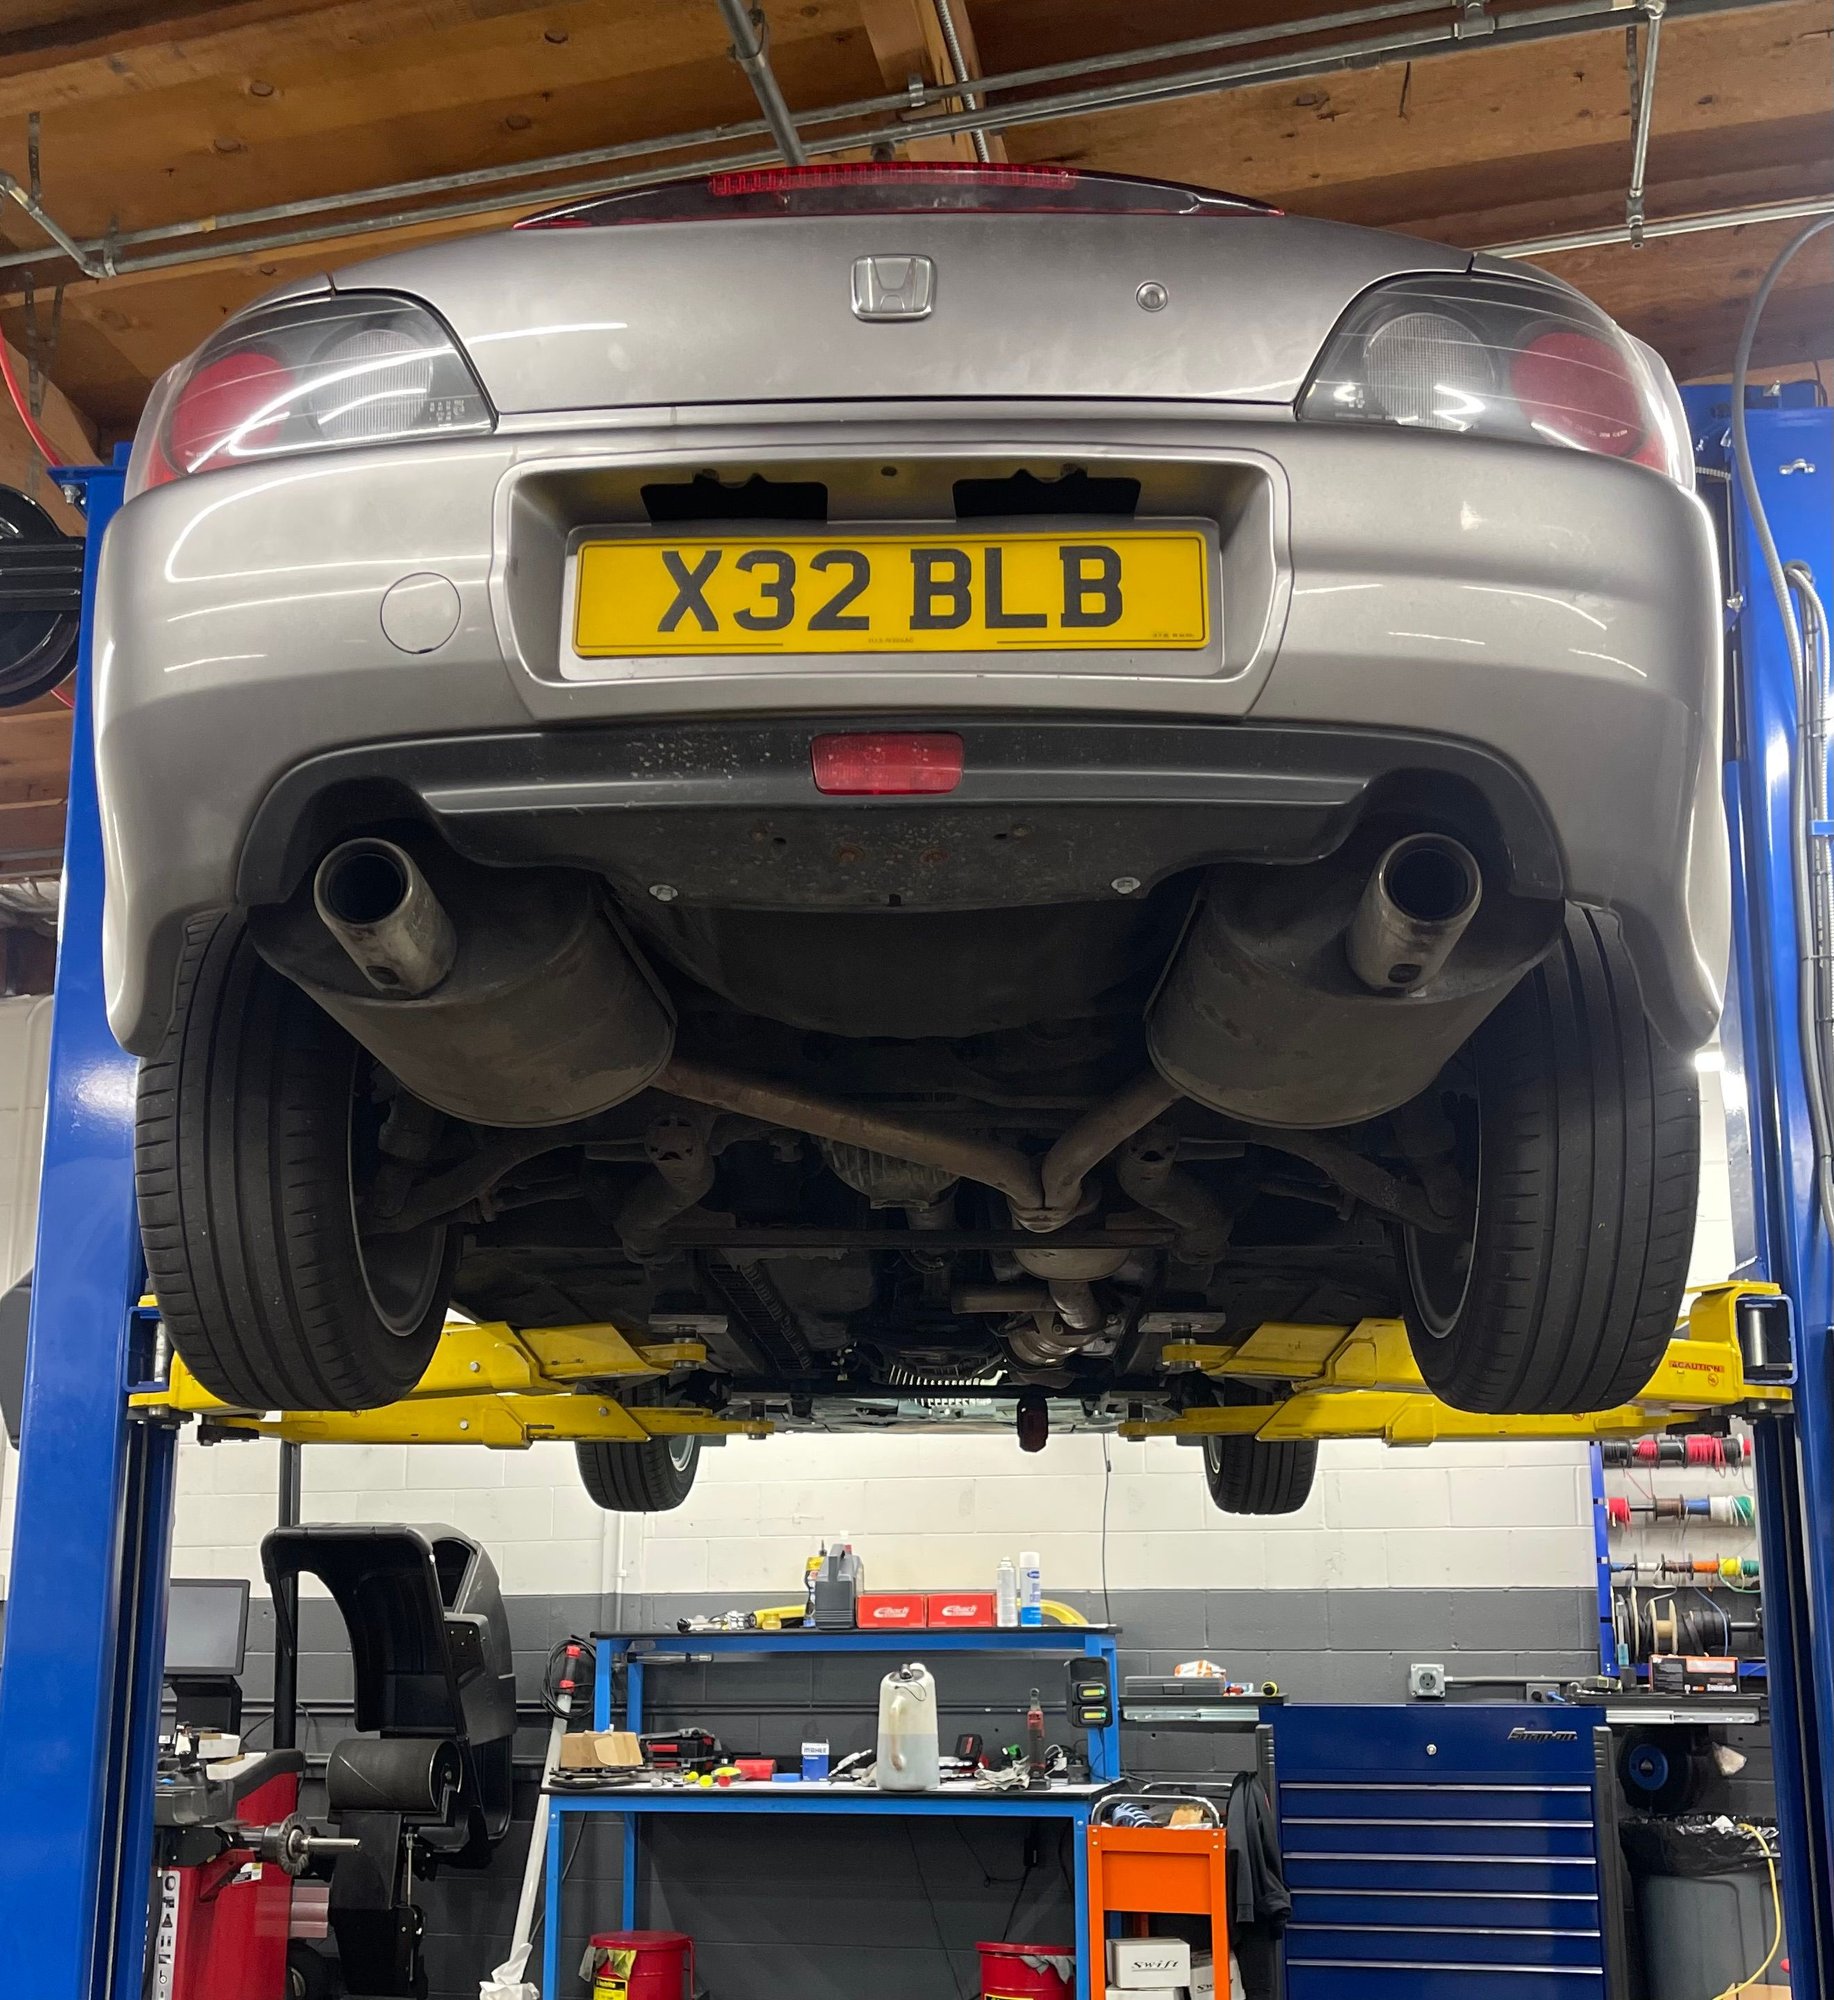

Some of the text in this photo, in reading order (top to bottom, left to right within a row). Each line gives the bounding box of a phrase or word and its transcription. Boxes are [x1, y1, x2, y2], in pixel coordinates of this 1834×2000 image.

[657, 544, 1123, 633] X32 BLB
[1677, 1361, 1721, 1373] CAUTION
[1131, 1959, 1180, 1969] Swift
